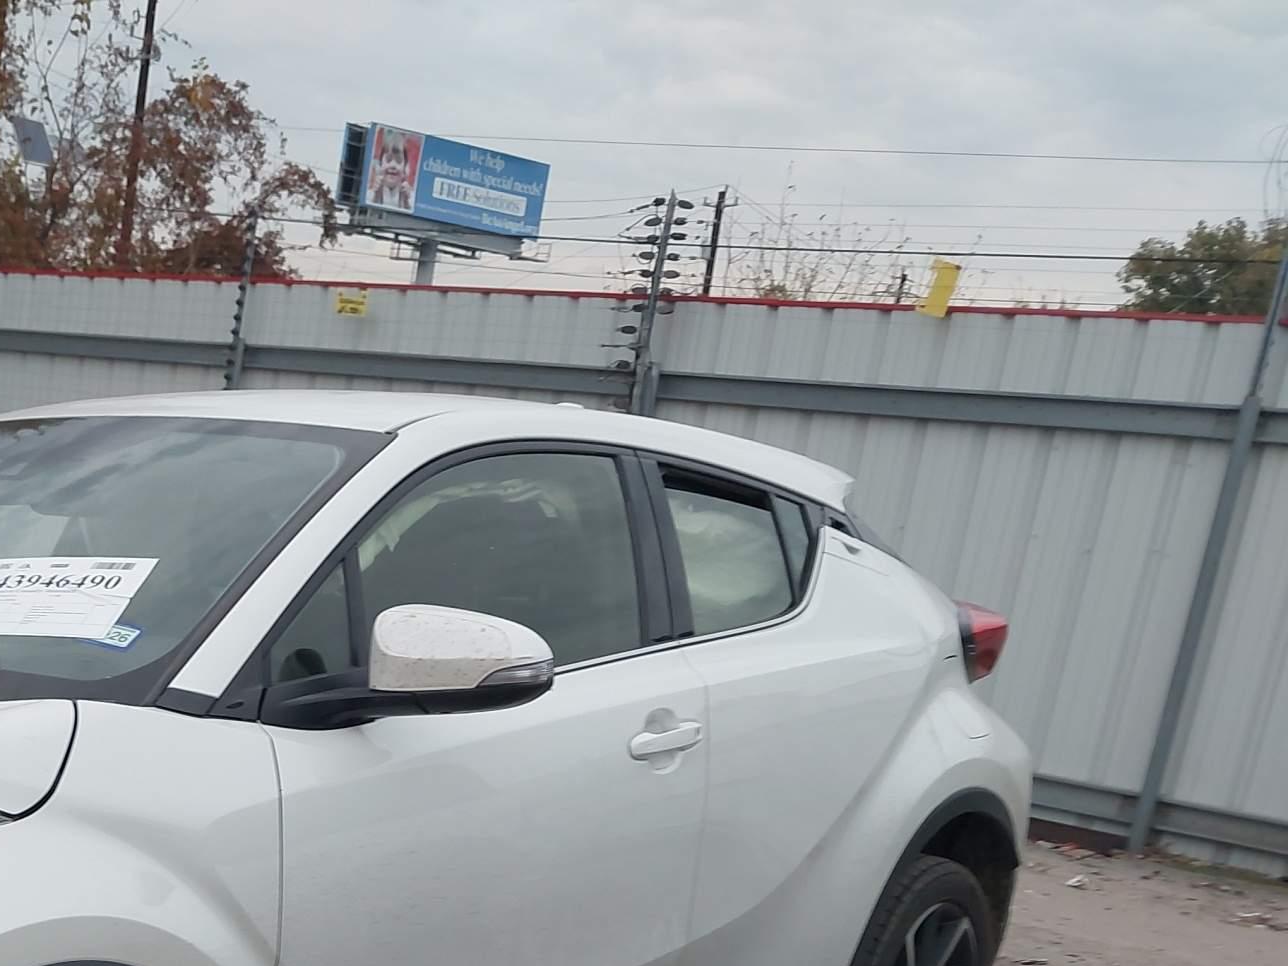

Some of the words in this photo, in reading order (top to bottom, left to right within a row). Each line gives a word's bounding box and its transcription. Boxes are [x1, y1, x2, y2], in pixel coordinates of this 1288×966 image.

[470, 148, 484, 165] We
[485, 152, 505, 173] help
[423, 156, 461, 178] children
[462, 168, 482, 183] with
[483, 174, 514, 191] special
[439, 181, 471, 202] FREE
[108, 631, 131, 643] 26
